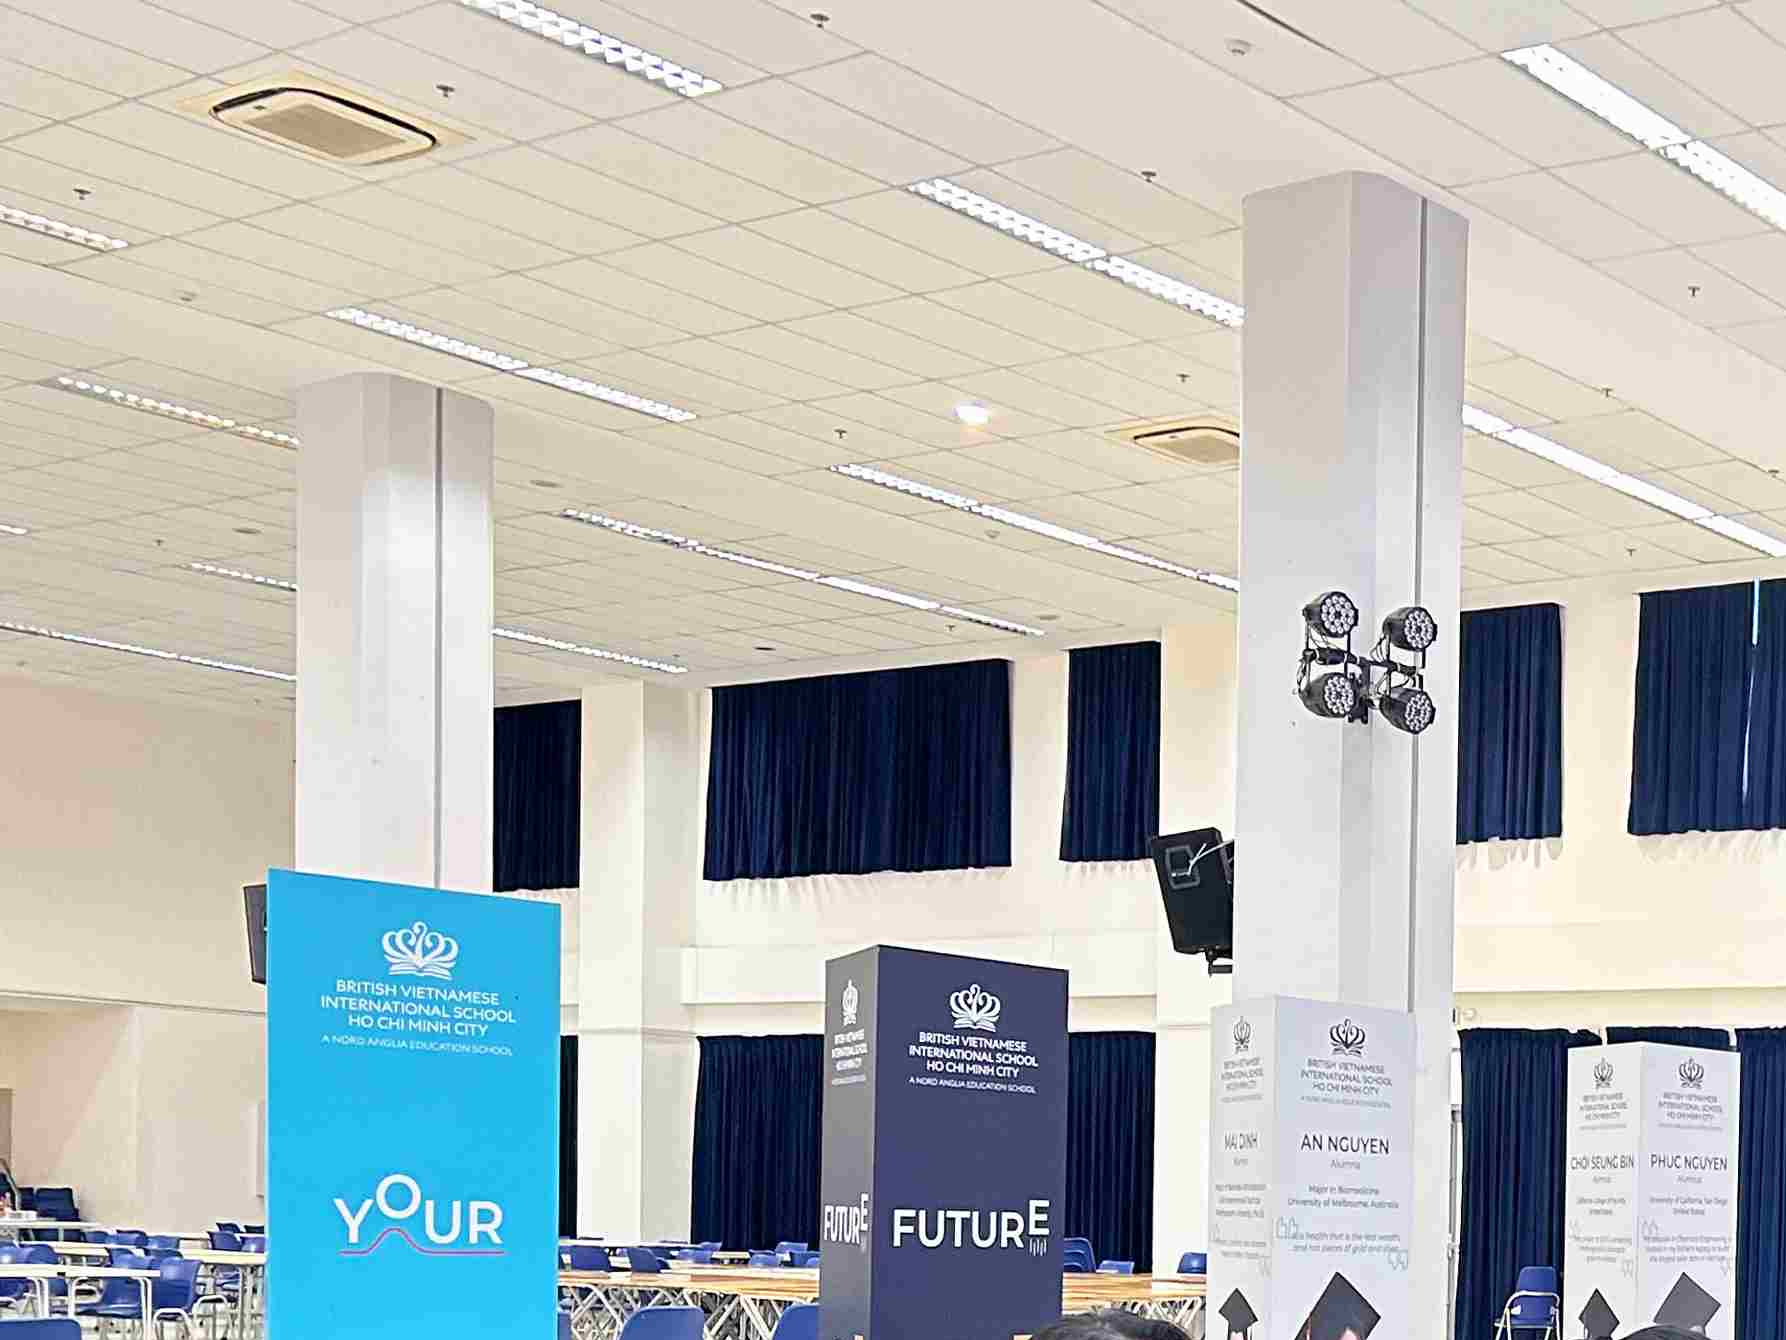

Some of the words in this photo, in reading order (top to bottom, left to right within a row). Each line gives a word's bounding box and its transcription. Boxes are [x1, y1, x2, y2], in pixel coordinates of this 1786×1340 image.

[336, 979, 397, 997] BRITISH
[400, 984, 500, 1006] VIETNAMESE
[320, 995, 450, 1019] INTERNATIONAL
[453, 1007, 517, 1023] SCHOOL
[348, 1015, 374, 1029] HO
[378, 1017, 405, 1032] CHI
[408, 1019, 451, 1034] MINH
[454, 1022, 489, 1037] CITY
[320, 1034, 331, 1045] A
[332, 1035, 365, 1046] NORD
[367, 1038, 408, 1050] ANGLIA
[409, 1041, 472, 1054] EDUCATION
[472, 1046, 513, 1056] SCHOOL
[919, 1031, 960, 1046] BRITISH
[961, 1036, 1028, 1052] VIETNAMESE
[909, 1045, 994, 1063] INTERNATIONAL
[996, 1053, 1039, 1067] SCHOOL
[926, 1060, 944, 1072] HO
[945, 1062, 965, 1073] CHI
[966, 1065, 995, 1076] MINH
[996, 1067, 1020, 1078] CITY
[1300, 1070, 1361, 1083] INTERNATIONAL
[1300, 1132, 1323, 1151] AN
[1327, 1136, 1390, 1155] NGUYEN
[1570, 1156, 1589, 1170] CHOI
[1591, 1155, 1618, 1170] SEUNG
[1619, 1154, 1634, 1169] BIN
[1650, 1154, 1682, 1169] PHUC
[1684, 1155, 1728, 1170] NGUYEN
[333, 1173, 504, 1245] YOUR
[1288, 1198, 1321, 1208] University
[824, 1194, 869, 1244] FUTURE
[893, 1199, 1050, 1250] FUTURE
